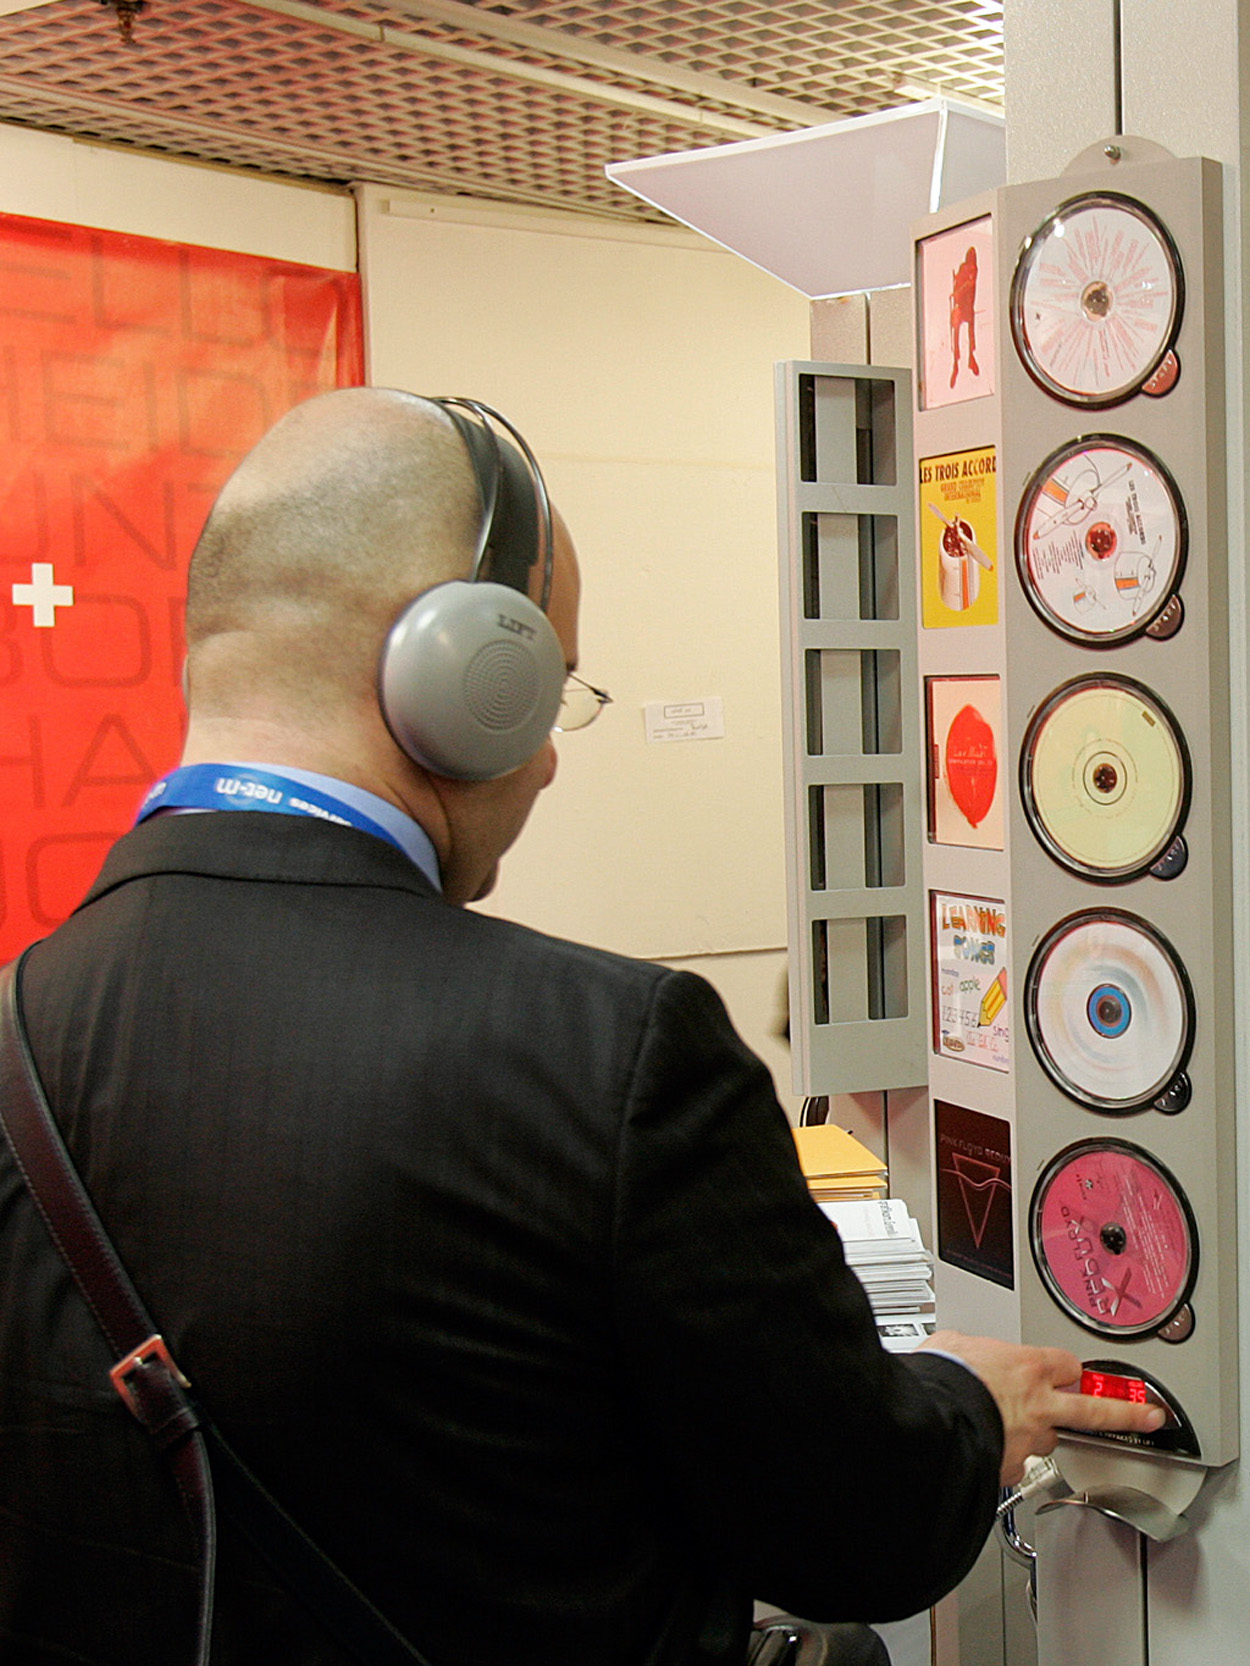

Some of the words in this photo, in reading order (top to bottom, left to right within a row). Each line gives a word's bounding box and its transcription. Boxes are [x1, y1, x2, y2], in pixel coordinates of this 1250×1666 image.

[934, 461, 959, 482] TROIS
[215, 777, 283, 805] net-m
[941, 902, 1006, 938] LEARNING
[1093, 1382, 1103, 1398] 2
